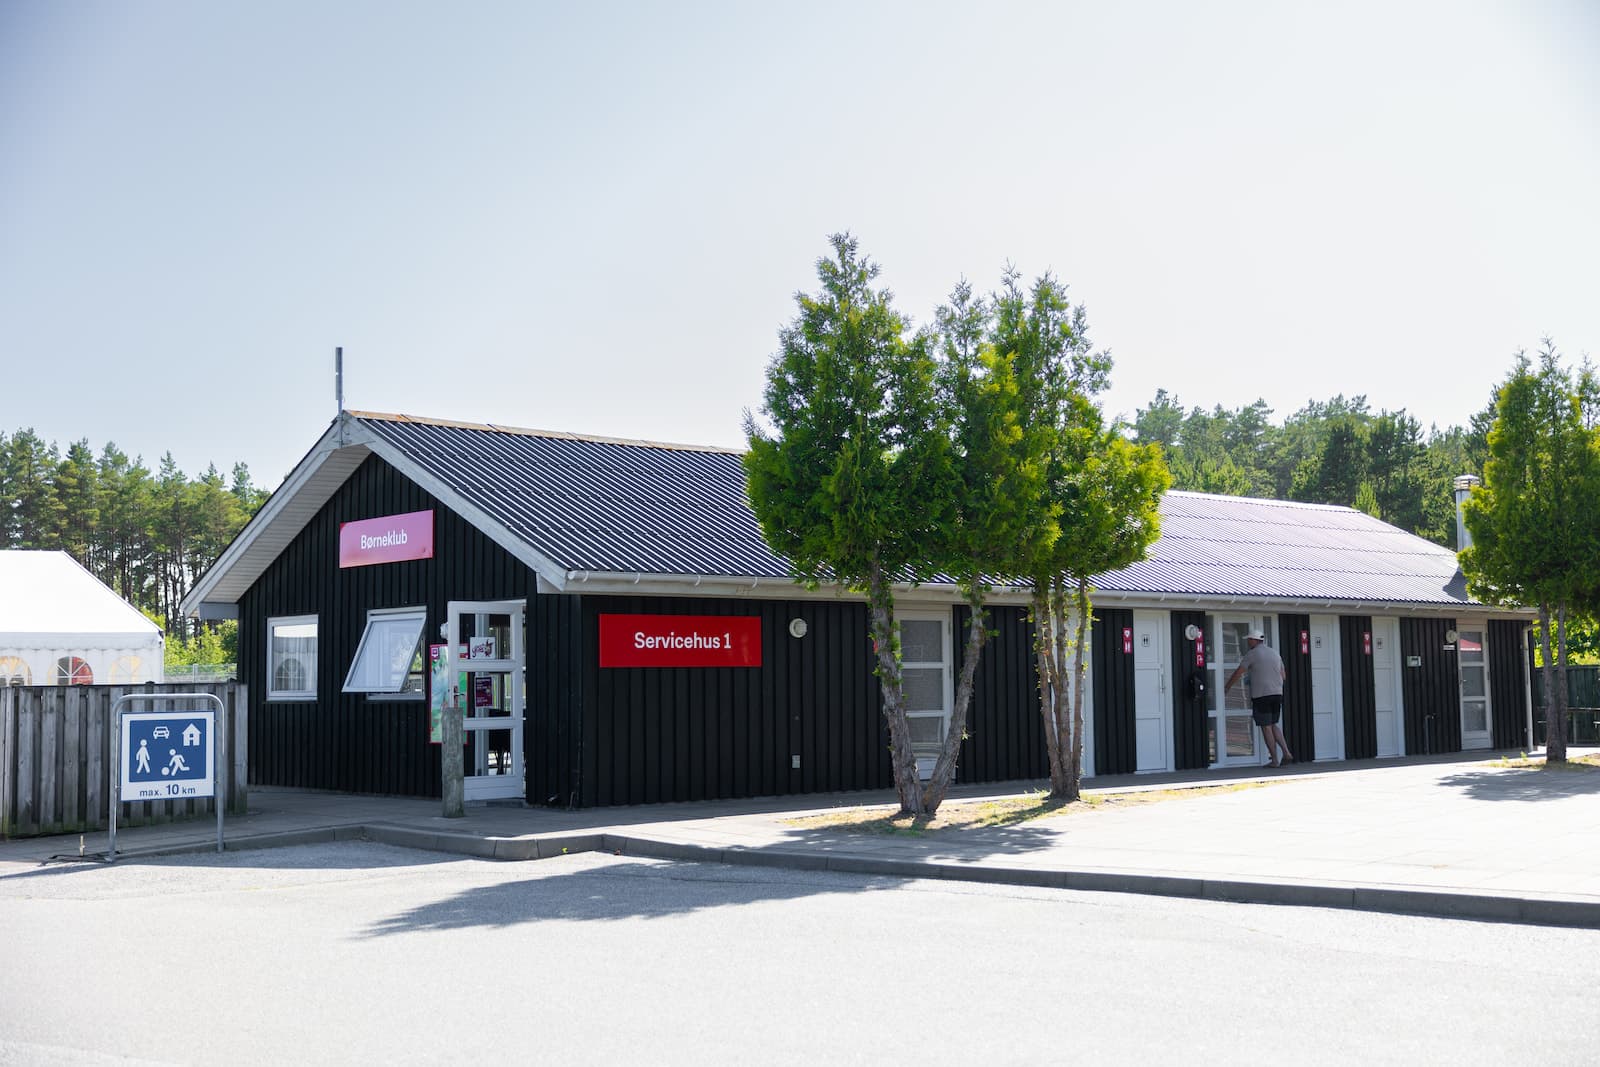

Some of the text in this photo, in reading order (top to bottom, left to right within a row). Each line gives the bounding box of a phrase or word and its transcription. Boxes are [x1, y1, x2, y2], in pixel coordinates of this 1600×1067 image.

[361, 529, 408, 549] Børneklub
[634, 631, 731, 648] Servicehus 1
[139, 789, 162, 797] max.
[166, 784, 179, 795] 10
